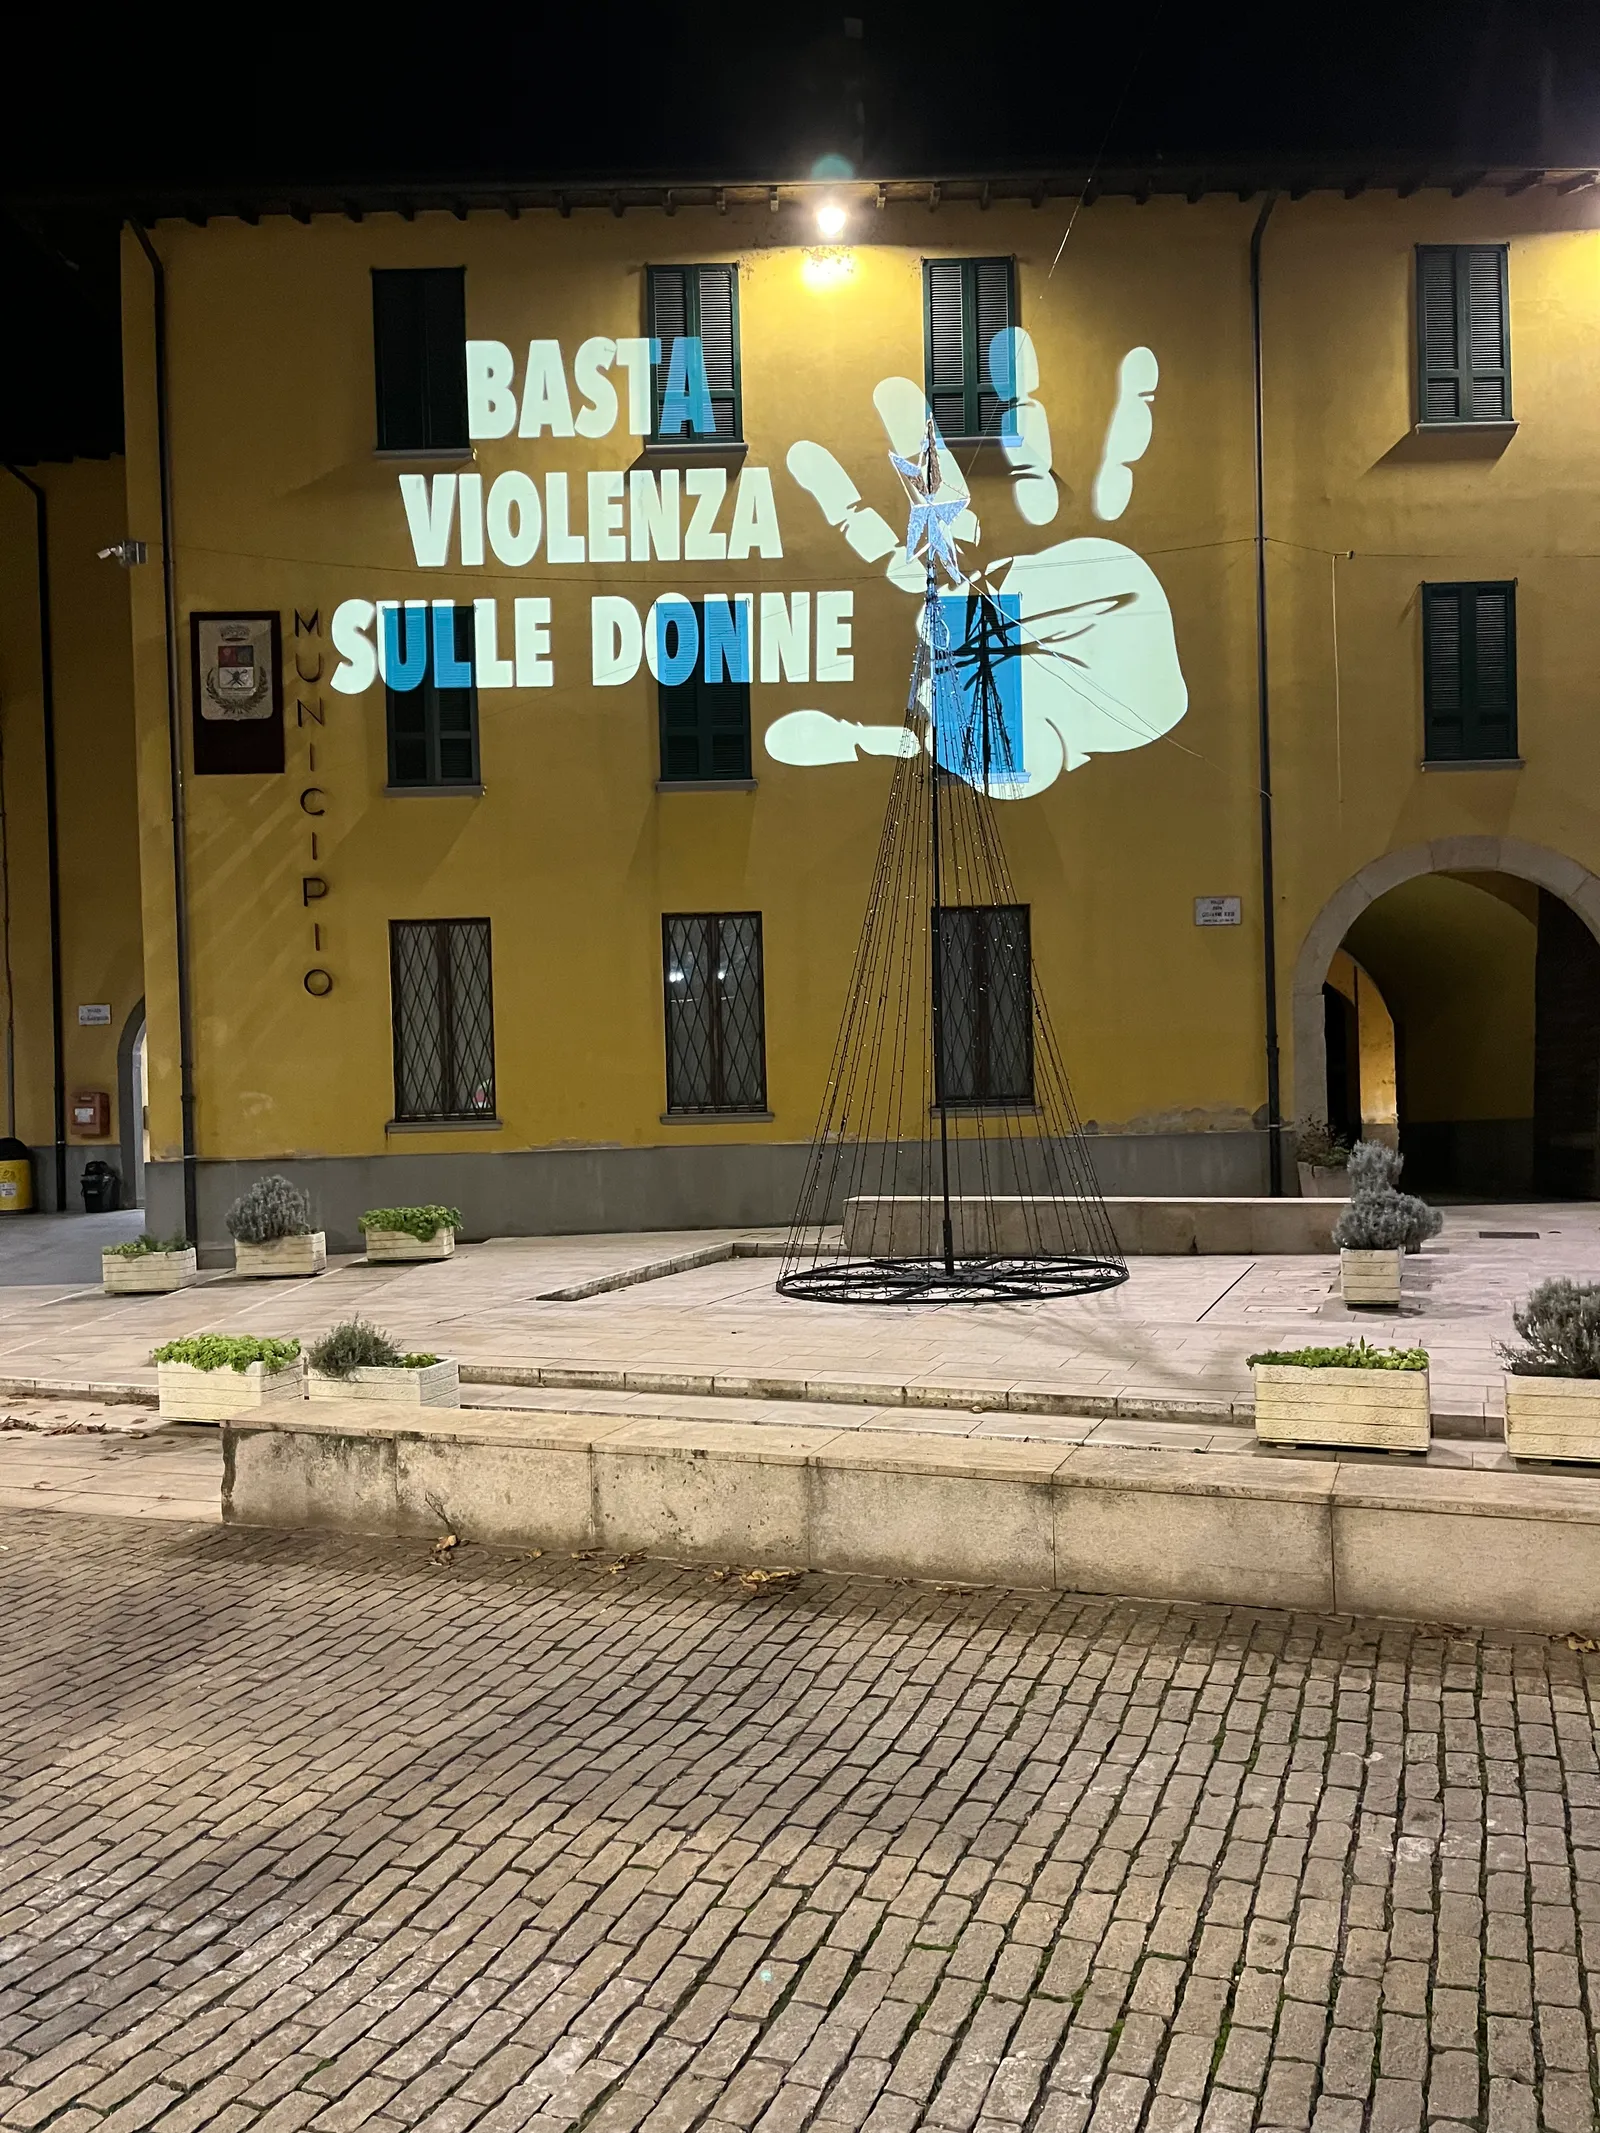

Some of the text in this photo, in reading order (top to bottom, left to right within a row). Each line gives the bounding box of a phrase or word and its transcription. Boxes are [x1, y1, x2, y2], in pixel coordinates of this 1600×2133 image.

[466, 336, 716, 440] BASTA
[398, 467, 784, 567] VIOLENZA
[330, 590, 855, 694] SULLE DONNE
[294, 607, 333, 997] MUNICIPIO
